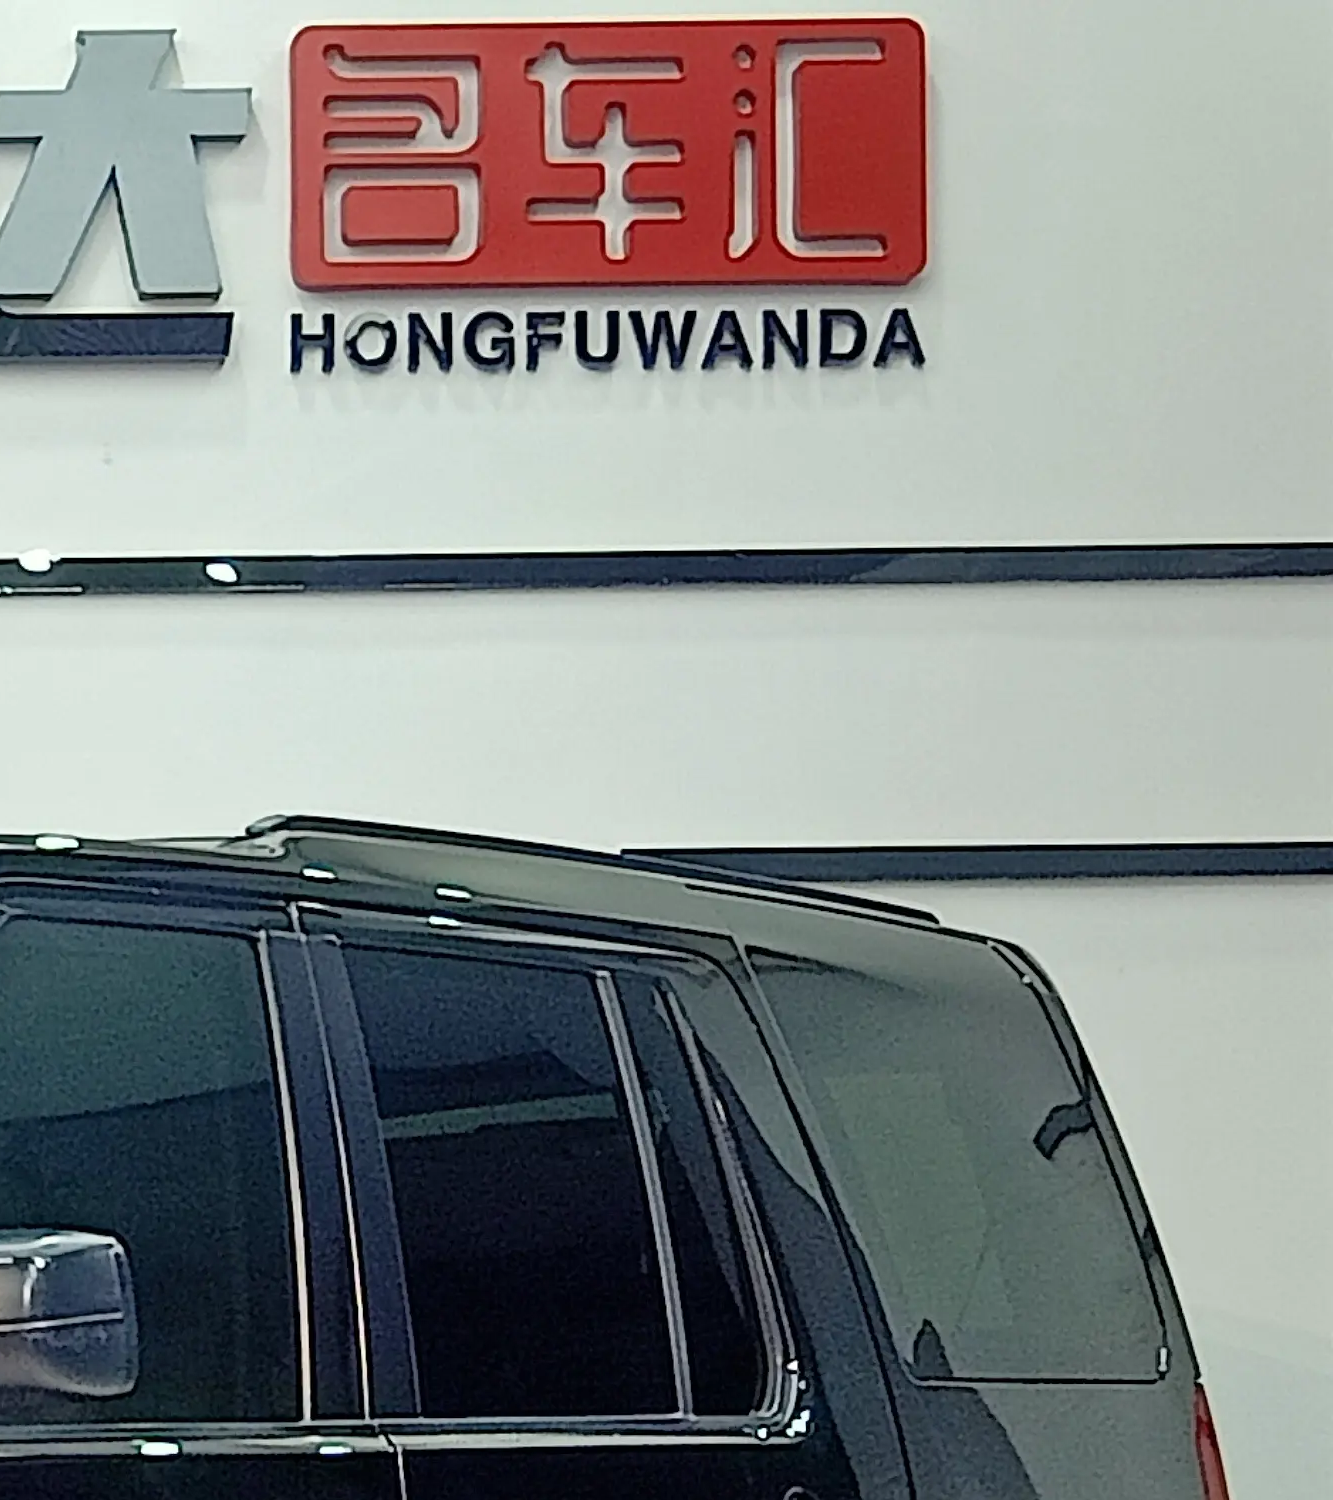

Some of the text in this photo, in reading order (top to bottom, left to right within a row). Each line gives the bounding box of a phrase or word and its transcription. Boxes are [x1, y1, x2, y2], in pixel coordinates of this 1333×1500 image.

[322, 38, 885, 265] 名车汇
[289, 307, 926, 373] HONGFUWANDA
